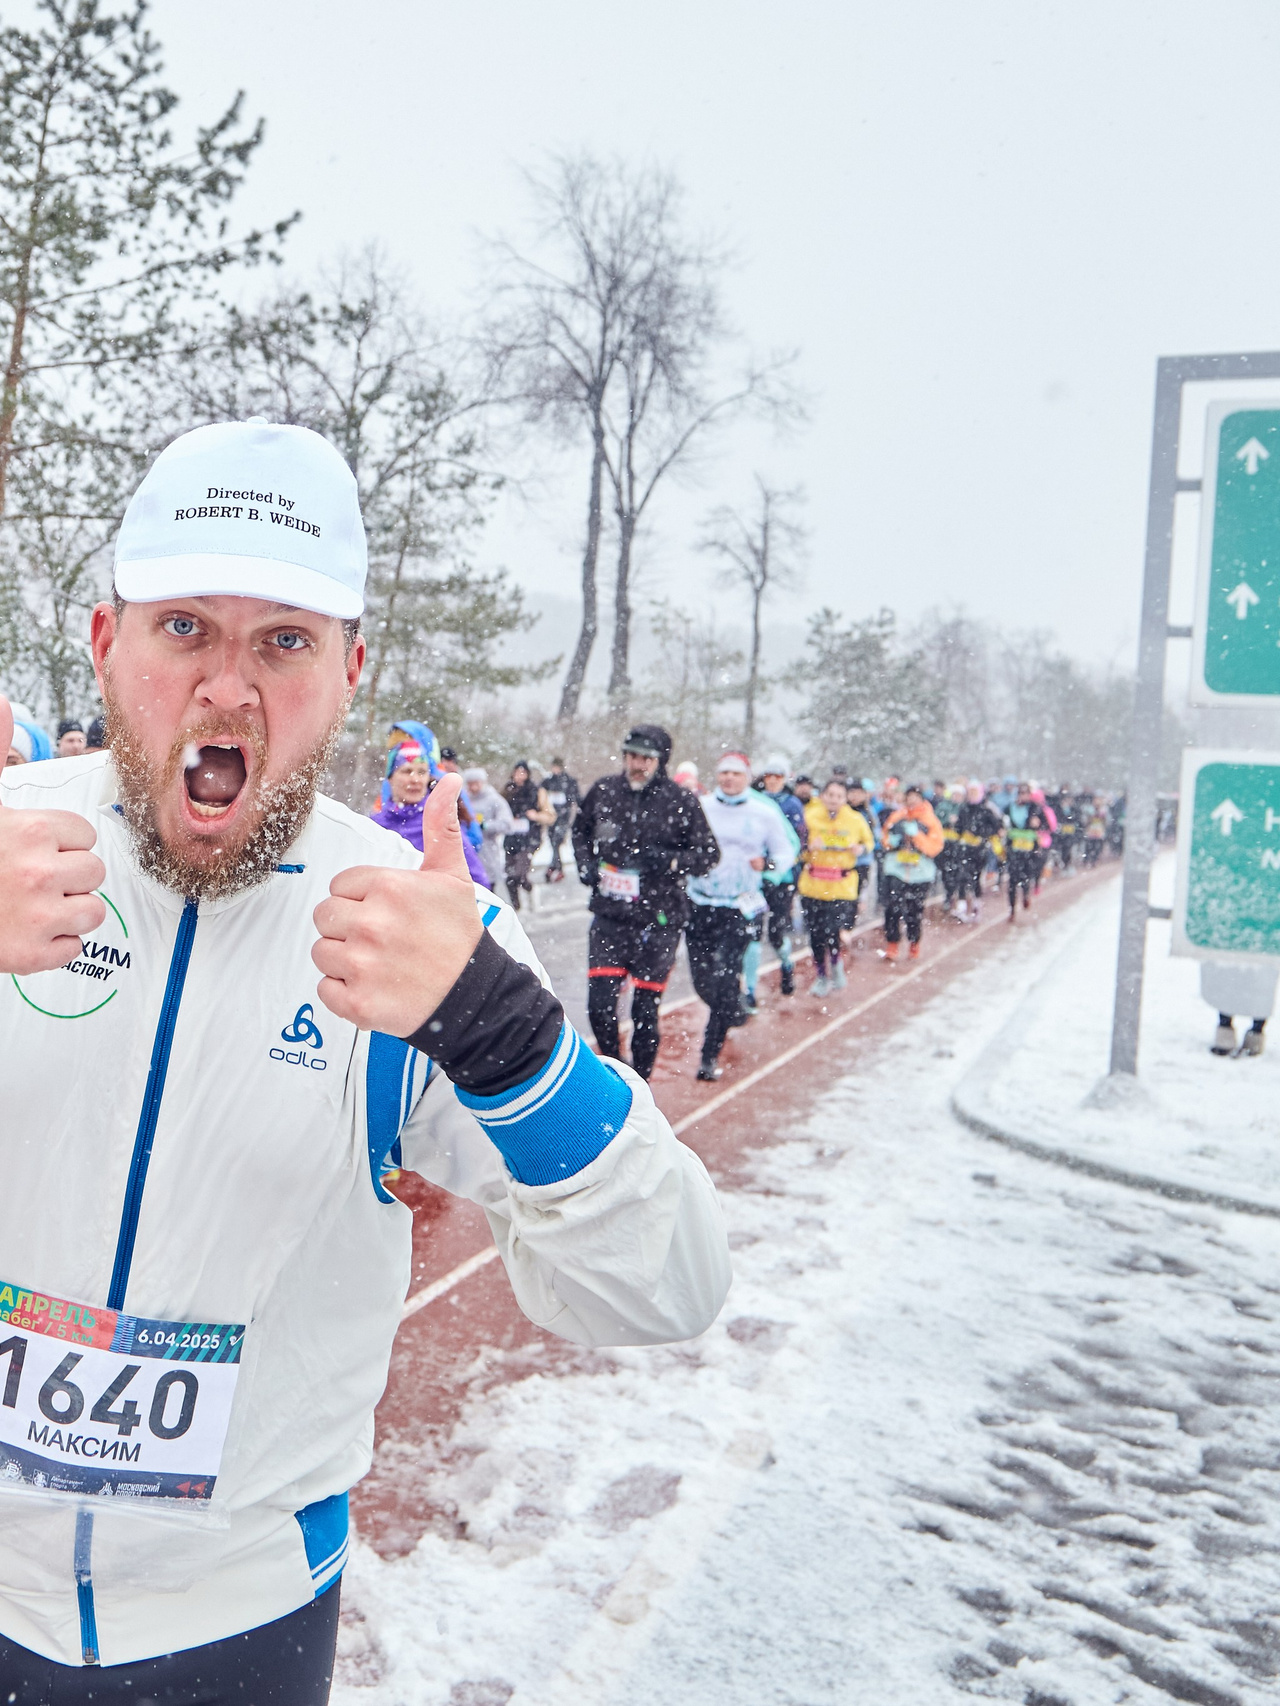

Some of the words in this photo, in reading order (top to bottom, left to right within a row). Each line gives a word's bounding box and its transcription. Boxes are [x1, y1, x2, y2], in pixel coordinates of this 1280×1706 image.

[206, 487, 273, 504] Directed
[278, 494, 295, 511] by
[174, 506, 243, 521] ROBERT
[248, 508, 263, 521] B.
[269, 511, 321, 538] WEIDE
[61, 960, 114, 981] ACTORY
[269, 1047, 327, 1071] odlo
[56, 1324, 67, 1338] 5
[71, 1331, 94, 1345] км
[138, 1328, 221, 1349] 6.04.2025
[27, 1420, 142, 1463] МАКСИМ
[116, 1482, 161, 1493] МОСКОВСКИЙ
